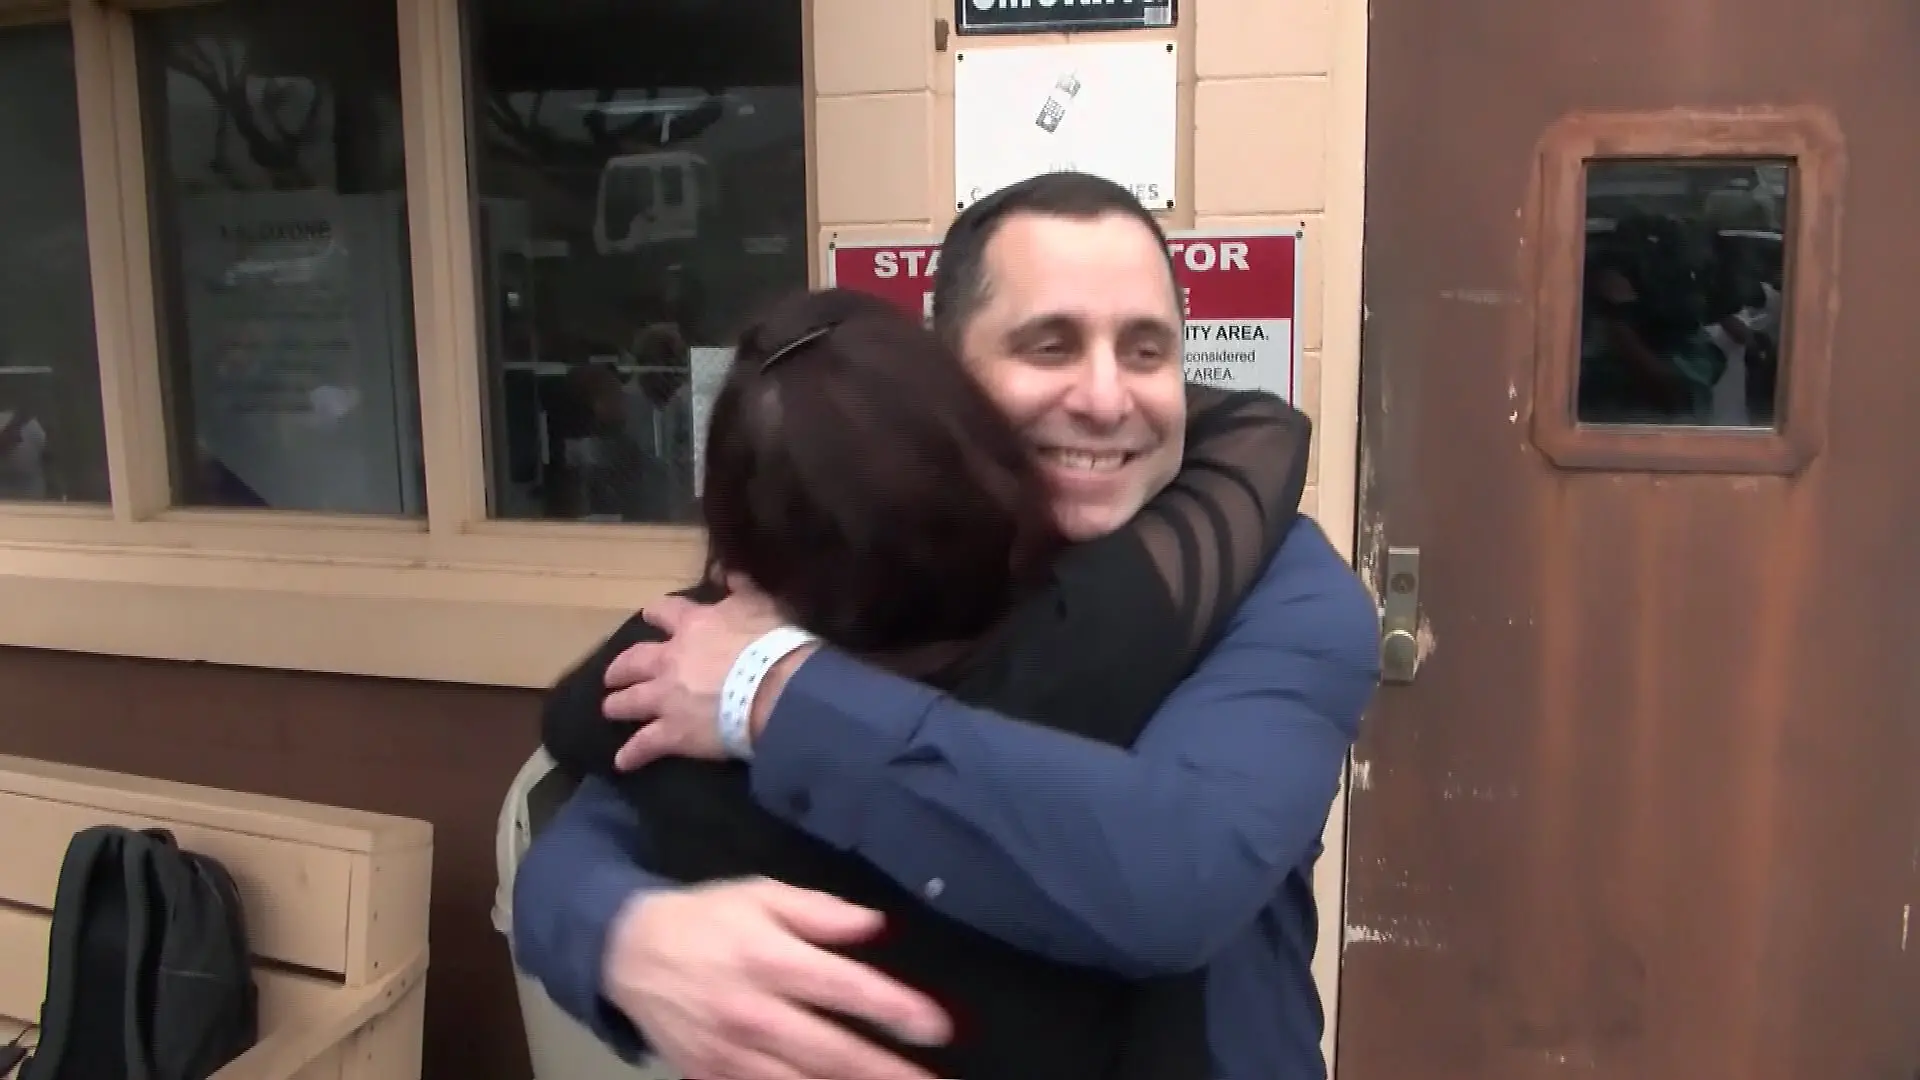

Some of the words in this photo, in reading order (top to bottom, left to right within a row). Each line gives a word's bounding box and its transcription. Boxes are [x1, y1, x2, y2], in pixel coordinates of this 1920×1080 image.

[1215, 325, 1269, 341] AREA.
[1185, 350, 1256, 363] considered
[1193, 367, 1236, 381] AREA.
